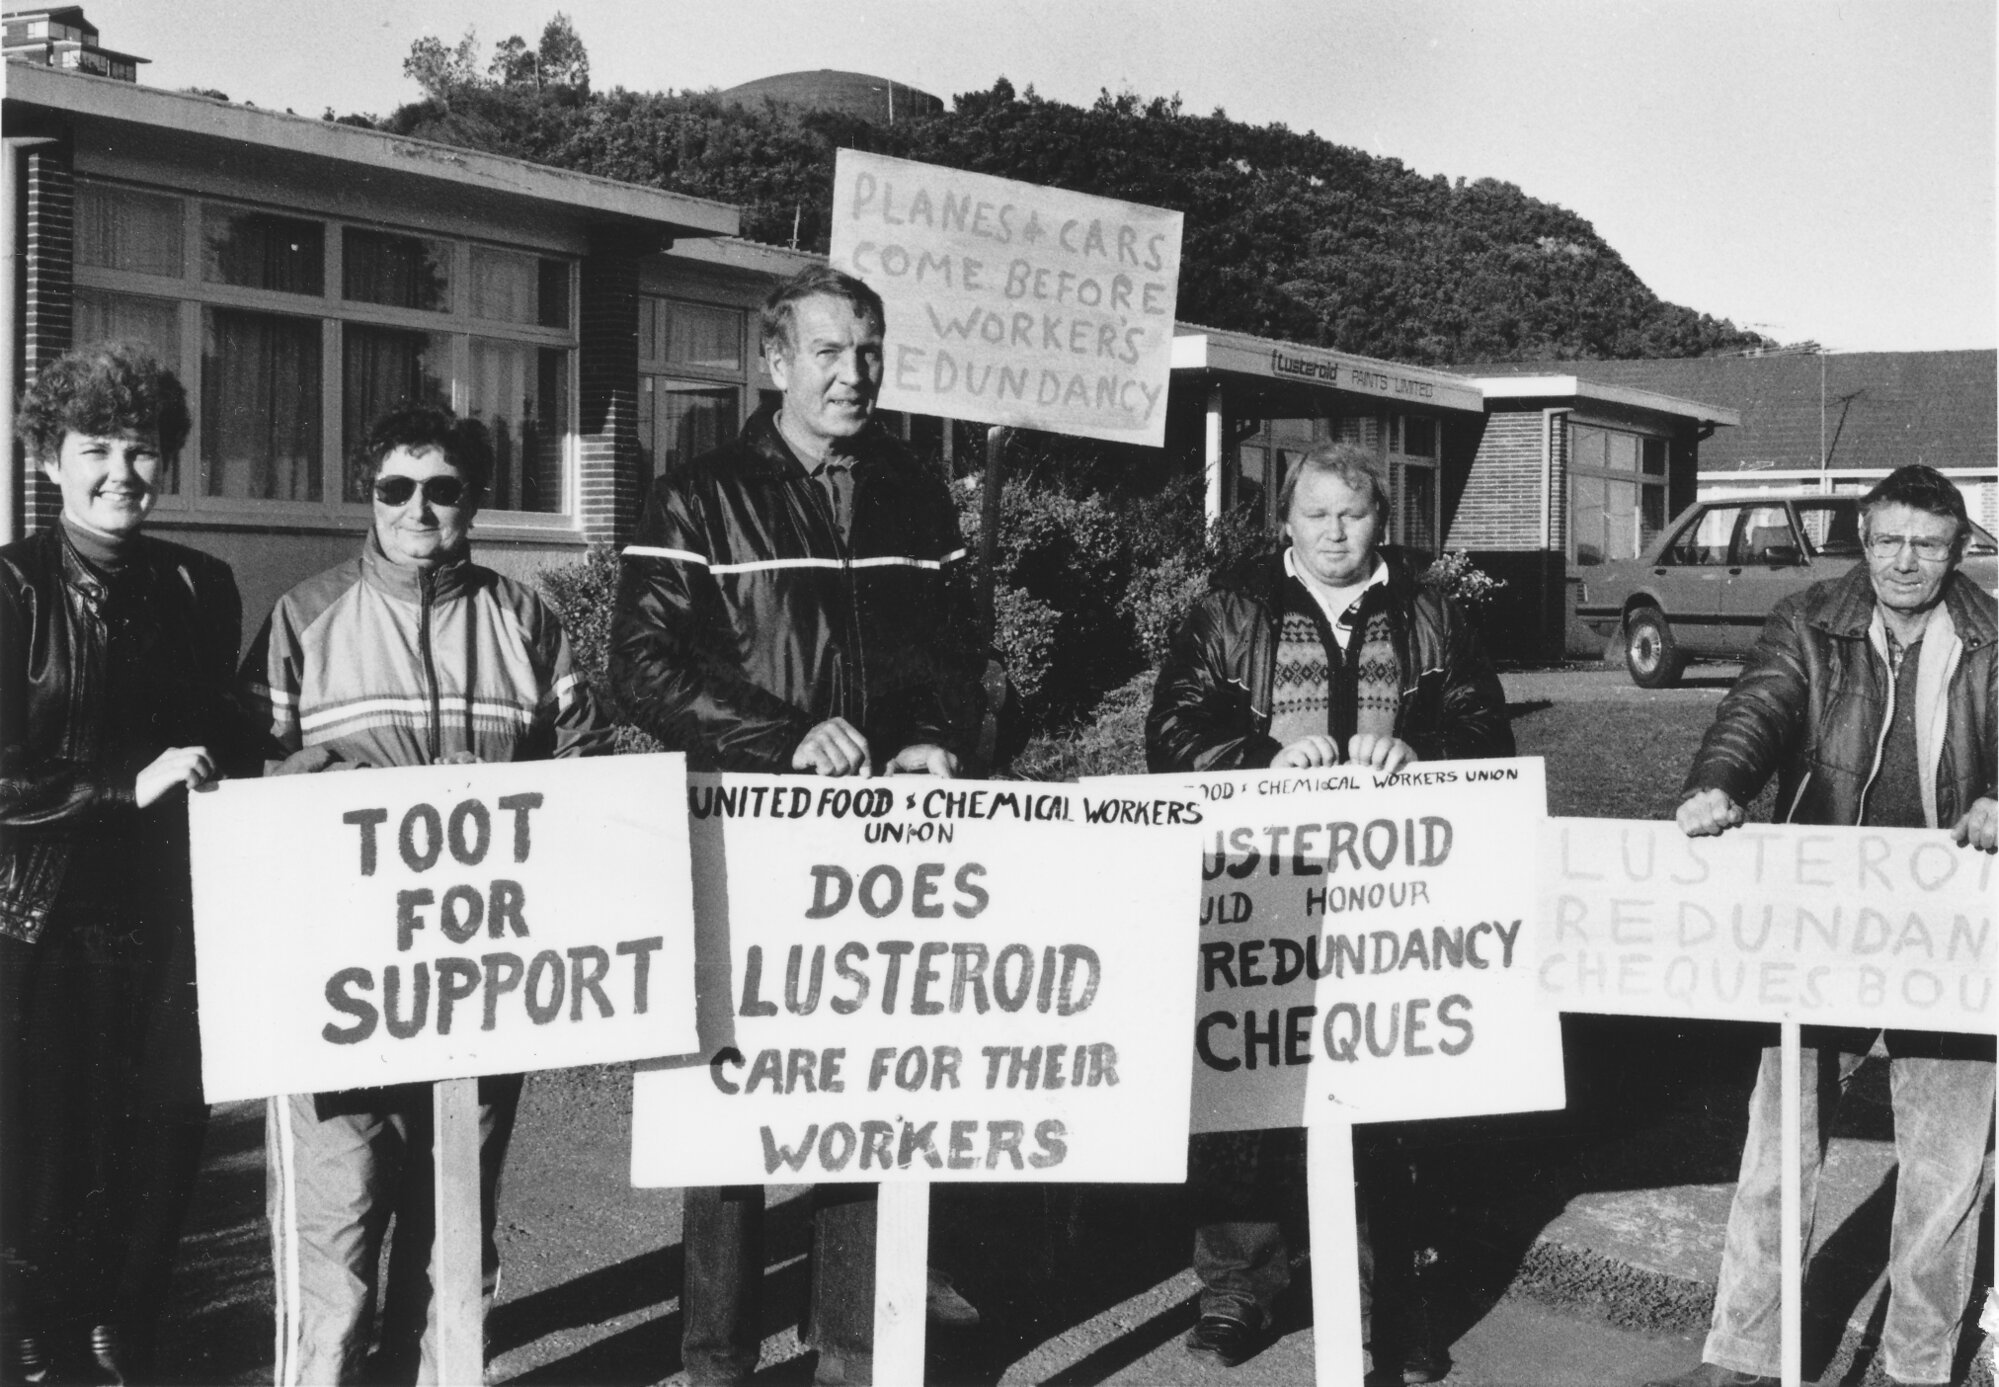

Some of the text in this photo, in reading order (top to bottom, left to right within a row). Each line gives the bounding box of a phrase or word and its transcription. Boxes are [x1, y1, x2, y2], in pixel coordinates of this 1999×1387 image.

[851, 171, 1015, 245] PLANES
[1059, 218, 1166, 273] CARS
[852, 240, 1168, 316] COME BEFORE
[925, 303, 1145, 366] WORKER'S
[896, 344, 1163, 421] EDUNDANCY
[1352, 369, 1388, 391] PAINTS
[1395, 376, 1433, 398] LIMITED
[690, 785, 812, 819] UNITED
[816, 787, 894, 819] FOOD
[922, 788, 1075, 822] CHEMICAL
[1083, 797, 1204, 826] WORKERS
[1258, 775, 1361, 796] CHEMICAL
[1373, 768, 1459, 788] WORKERS
[1465, 766, 1519, 782] UNION
[342, 791, 544, 877] TOOT
[864, 821, 954, 845] UNION
[1202, 815, 1454, 881] USTEROID
[1561, 827, 1994, 893] LUSTEROI
[396, 879, 531, 952] FOR
[804, 862, 990, 920] DOES
[1199, 880, 1431, 926] ULD HONOUR
[1199, 919, 1523, 993] REDUNDANCY
[1555, 895, 1990, 962] REDUNDAN
[321, 936, 664, 1045] SUPPORT
[738, 940, 1101, 1018] LUSTEROID
[1858, 962, 1992, 1013] BOU
[1196, 993, 1475, 1073] CHEQUES
[709, 1041, 1120, 1096] CARE FOR THEIR
[759, 1119, 1067, 1175] WORKERS
